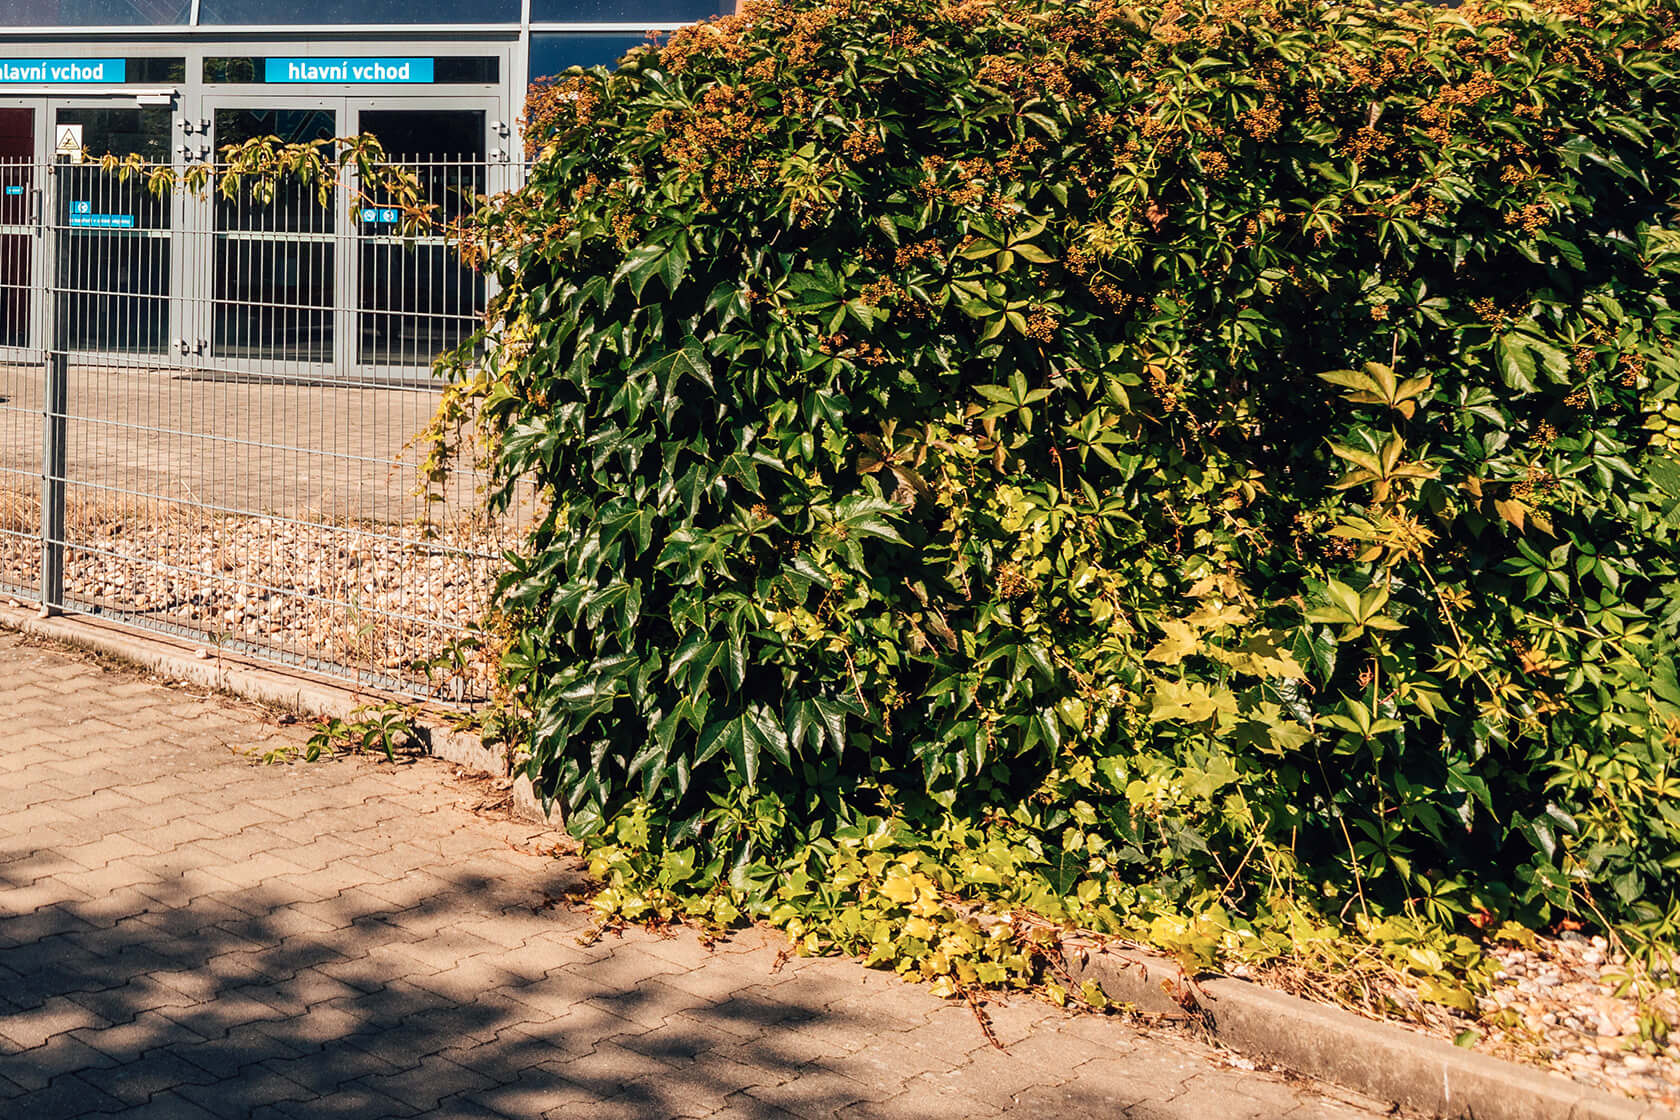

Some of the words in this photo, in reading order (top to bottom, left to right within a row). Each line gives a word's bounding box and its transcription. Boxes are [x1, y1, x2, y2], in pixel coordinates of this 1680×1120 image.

[51, 63, 104, 80] vchod
[288, 61, 348, 80] hlavní
[352, 62, 410, 80] vchod
